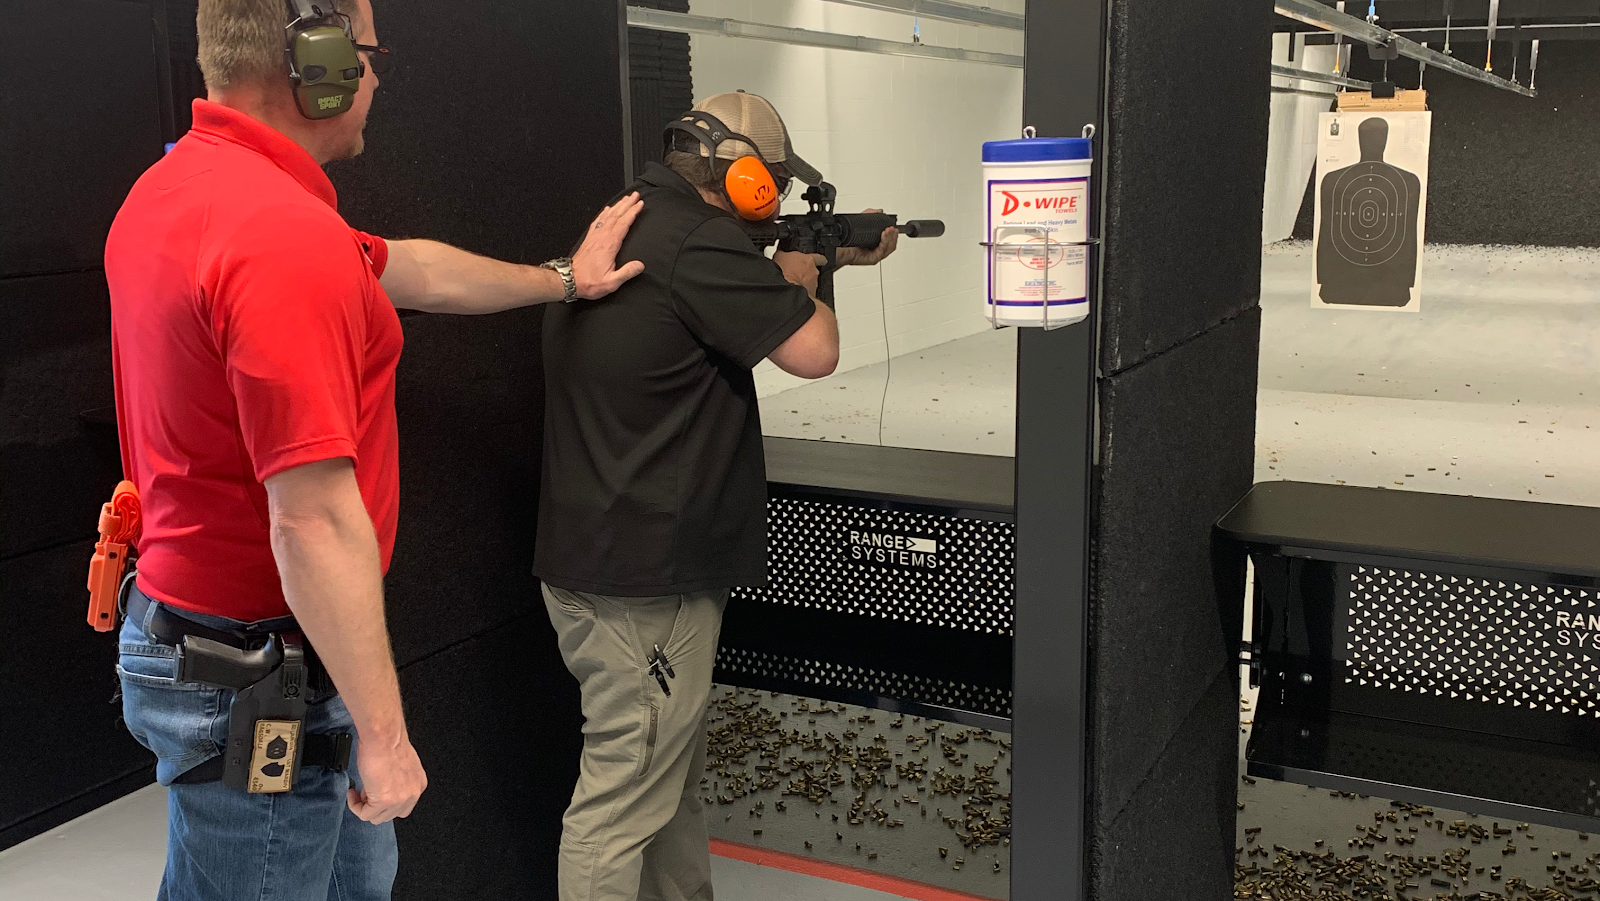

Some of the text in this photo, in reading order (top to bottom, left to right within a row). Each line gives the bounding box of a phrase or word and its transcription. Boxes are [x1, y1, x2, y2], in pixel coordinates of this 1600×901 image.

[318, 95, 344, 104] IMPACT
[320, 101, 341, 109] SPORT
[1001, 190, 1078, 216] D WIPE
[850, 530, 904, 549] RANGE
[851, 545, 937, 569] SYSTEMS
